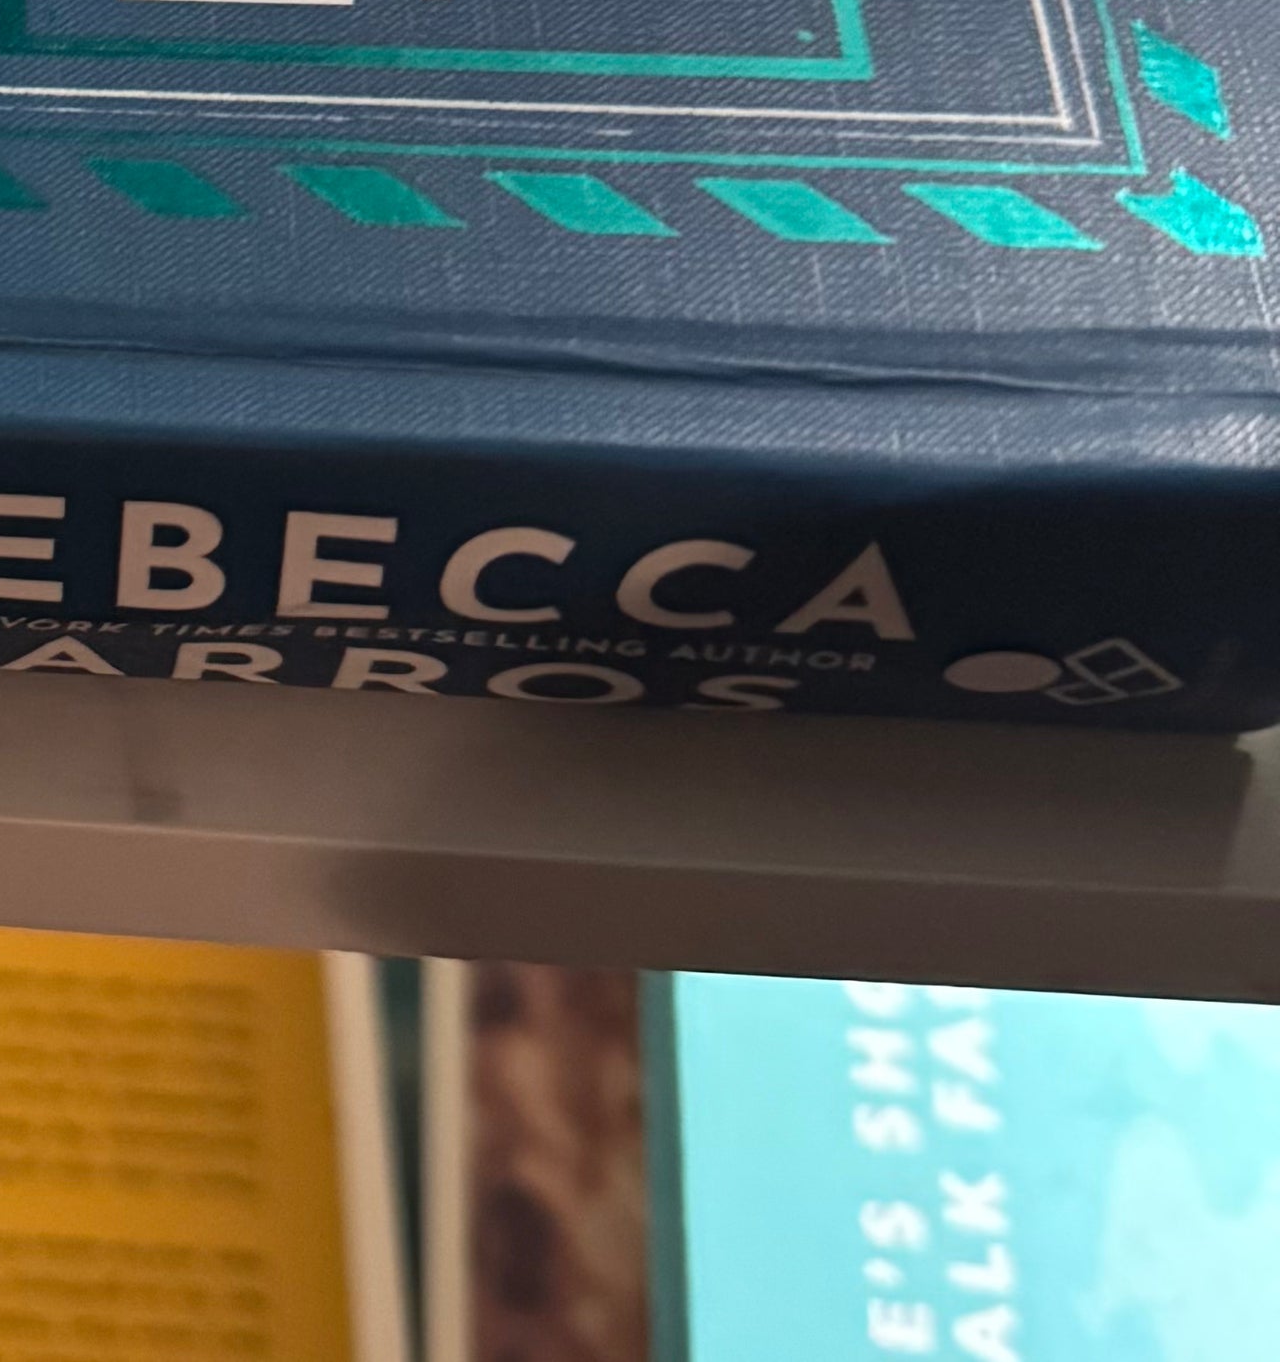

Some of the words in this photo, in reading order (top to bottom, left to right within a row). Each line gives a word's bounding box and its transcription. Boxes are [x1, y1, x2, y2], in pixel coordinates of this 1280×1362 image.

[151, 621, 297, 645] TIMES
[311, 623, 648, 659] BESTSELLING
[667, 642, 877, 672] AUTHOR
